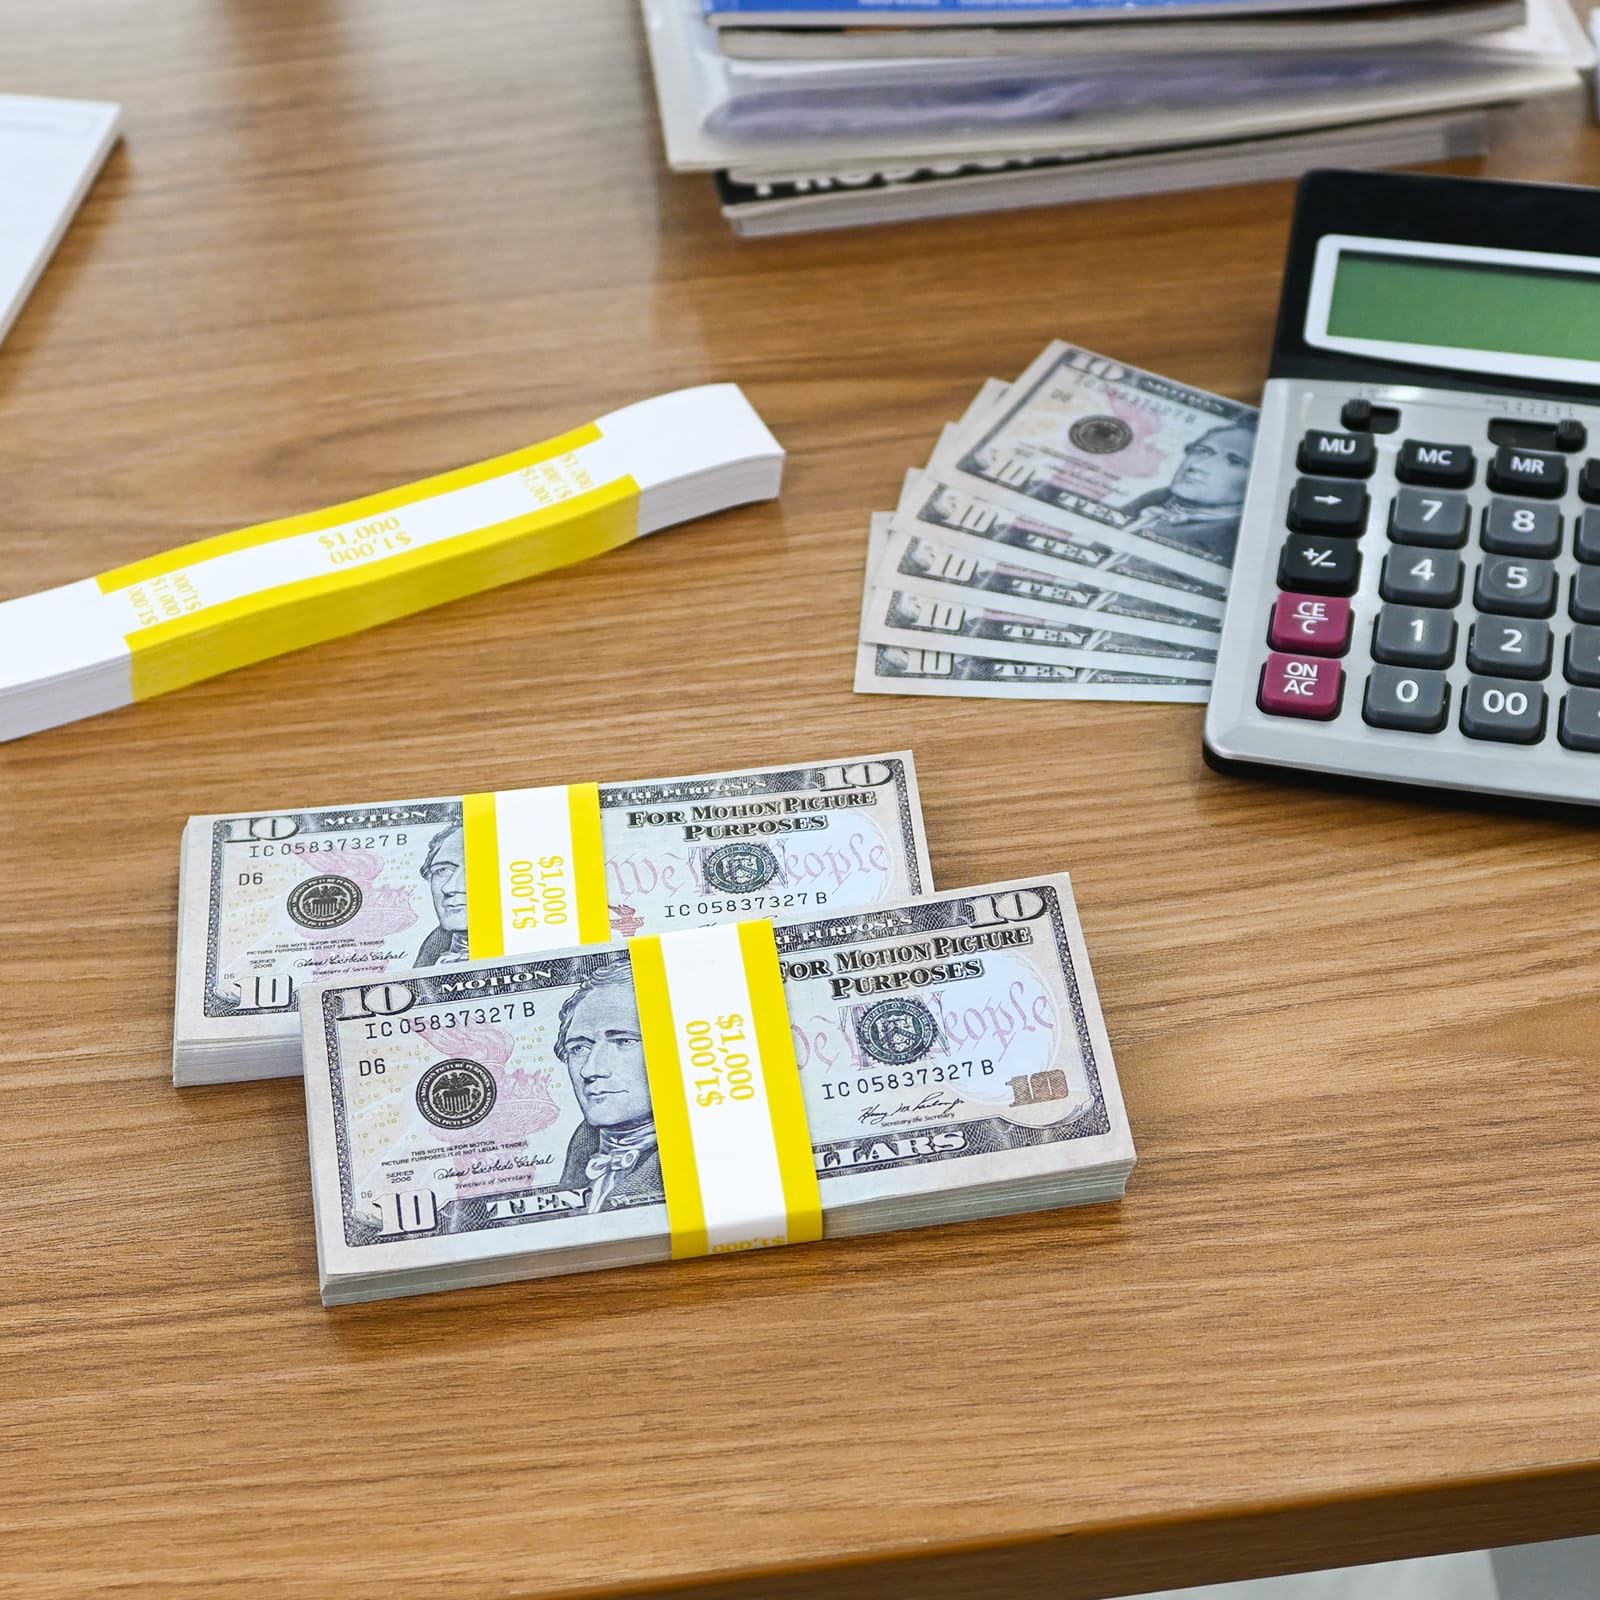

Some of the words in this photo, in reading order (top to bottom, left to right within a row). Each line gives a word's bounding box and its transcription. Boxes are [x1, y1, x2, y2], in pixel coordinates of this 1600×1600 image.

[1319, 437, 1356, 455] MU
[1417, 448, 1453, 466] MC
[1511, 457, 1546, 475] MR
[1058, 490, 1136, 526] TEN
[1420, 500, 1443, 522] 7
[1512, 510, 1536, 533] 8
[318, 516, 401, 550] $1,000
[329, 531, 413, 566] $1,000
[947, 499, 998, 533] 10
[1026, 534, 1108, 567] TEN
[925, 552, 979, 583] 10
[1012, 580, 1096, 605] TEN
[1410, 560, 1435, 582] 4
[1505, 567, 1528, 589] 5
[915, 600, 965, 632] 10
[1003, 624, 1090, 646] TEN
[1298, 602, 1325, 618] CE
[1302, 621, 1317, 635] C
[1411, 620, 1425, 642] 1
[1501, 630, 1522, 653] 2
[994, 663, 1079, 680] TEN
[1286, 662, 1318, 678] ON
[1283, 681, 1315, 697] AC
[1482, 690, 1529, 716] 00
[663, 781, 767, 797] PURPOSES
[817, 763, 894, 792] 10
[223, 817, 300, 843] 10
[323, 811, 428, 825] MOTION
[626, 811, 686, 829] FOR
[690, 800, 782, 823] MOTION
[783, 791, 878, 814] PICTURE
[281, 836, 389, 855] 05837327
[397, 834, 408, 846] B
[682, 814, 829, 843] PURPOSES
[239, 872, 263, 886] D6
[510, 860, 540, 929] $1,000
[537, 855, 568, 925] $1,000
[698, 893, 808, 915] 05837327
[817, 891, 828, 905] B
[802, 916, 914, 941] PURPOSES
[967, 891, 1048, 930] 10
[834, 943, 931, 974] MOTION
[932, 926, 1032, 958] PICTURE
[233, 974, 293, 1011] 10
[440, 969, 553, 993] MOTION
[830, 958, 984, 1000] PURPOSES
[335, 983, 417, 1021] 10
[400, 1004, 515, 1035] 05837327
[523, 1001, 536, 1018] B
[359, 1058, 386, 1077] D6
[686, 1020, 726, 1108] $1,000
[714, 1013, 756, 1101] $1,000
[857, 1061, 974, 1094] 05837327
[981, 1059, 994, 1076] B
[1005, 1068, 1069, 1108] 10
[381, 1158, 410, 1166] PICTURE
[427, 1147, 446, 1155] NOTE
[470, 1140, 496, 1149] MOTION
[360, 1190, 373, 1199] D6
[372, 1187, 438, 1237] 10
[486, 1187, 592, 1221] TEN
